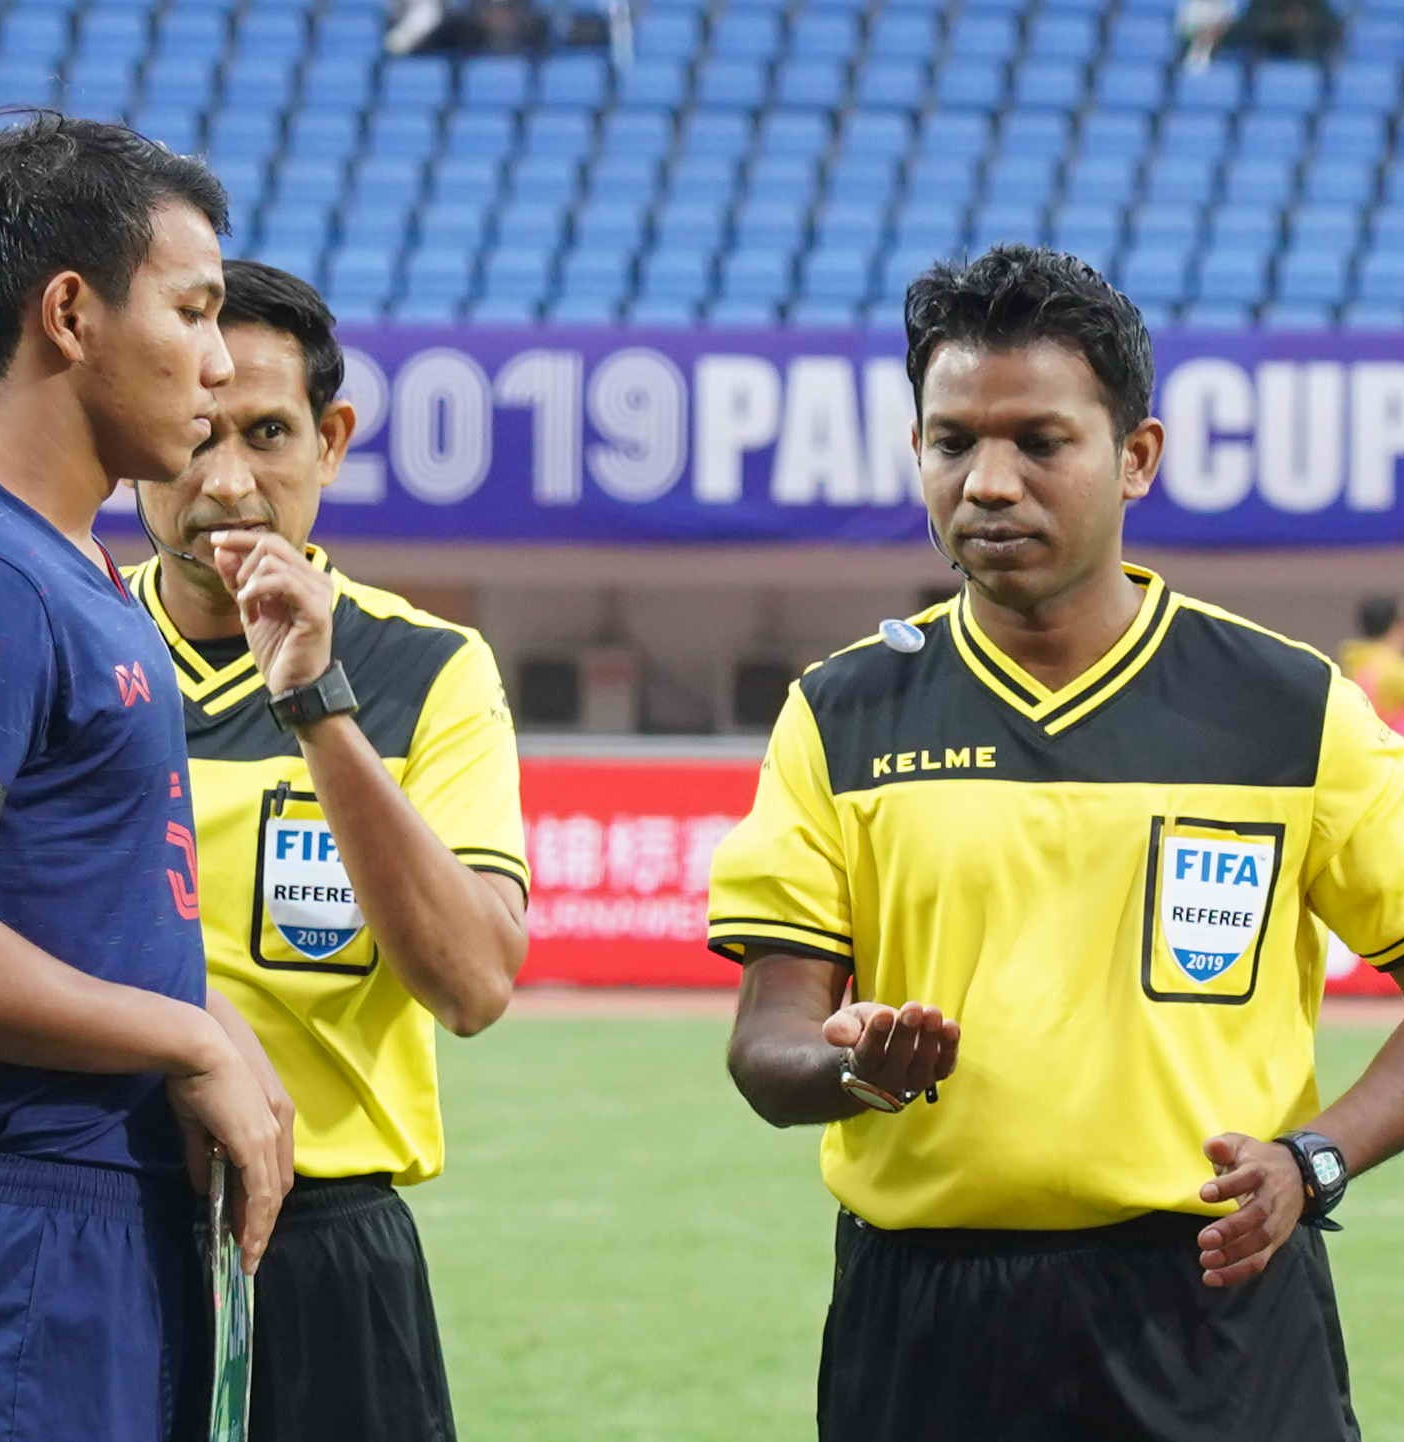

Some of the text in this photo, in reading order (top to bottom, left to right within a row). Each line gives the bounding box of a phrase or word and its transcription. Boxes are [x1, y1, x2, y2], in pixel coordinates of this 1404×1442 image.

[873, 746, 997, 778] KELME
[276, 830, 341, 862] FIF
[1175, 849, 1259, 887] FIFA
[274, 885, 357, 903] REFERE
[1172, 906, 1253, 928] REFEREE
[297, 930, 338, 946] 2019
[1186, 953, 1224, 972] 2019
